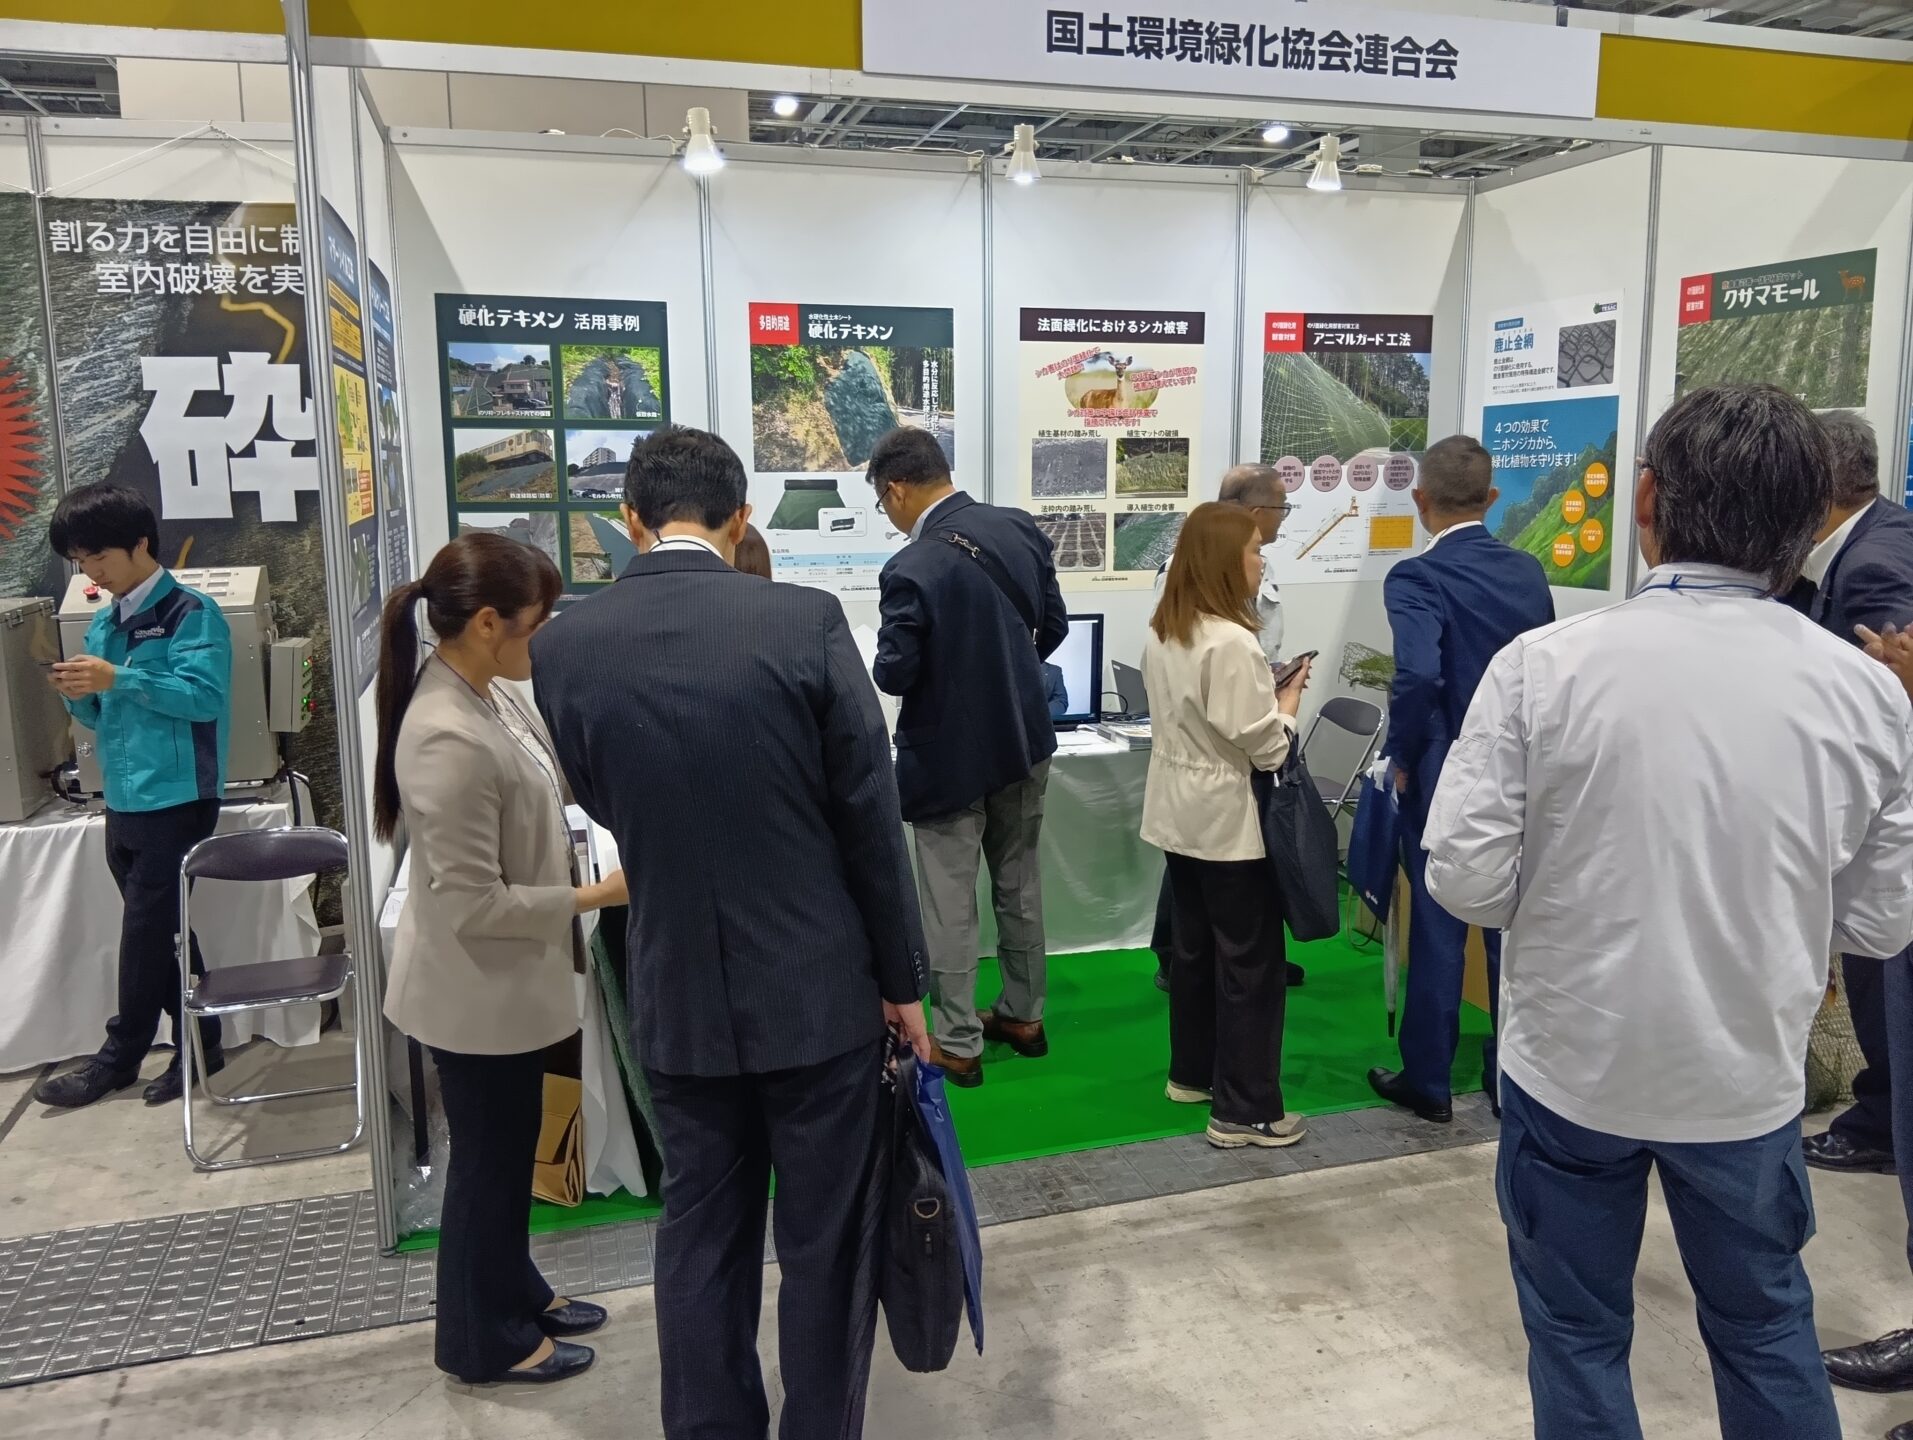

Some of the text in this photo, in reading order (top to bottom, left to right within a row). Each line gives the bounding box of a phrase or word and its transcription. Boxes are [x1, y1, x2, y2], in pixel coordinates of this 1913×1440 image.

[1046, 10, 1459, 80] 国土環境緑化協会連合会
[96, 261, 304, 295] 室内破壊を実
[1723, 279, 1820, 310] クサマモール
[458, 308, 640, 332] 硬化テキメン 活用事例
[758, 314, 790, 331] 多目的用途
[1037, 318, 1188, 334] 法面緑化におけるシカ被害
[808, 323, 893, 340] 硬化テキメン
[1494, 333, 1534, 353] 鹿止金網
[139, 352, 320, 522] 砕
[1492, 435, 1557, 451] ニホンジカから、
[1491, 453, 1577, 468] 緑化植物を守ります!
